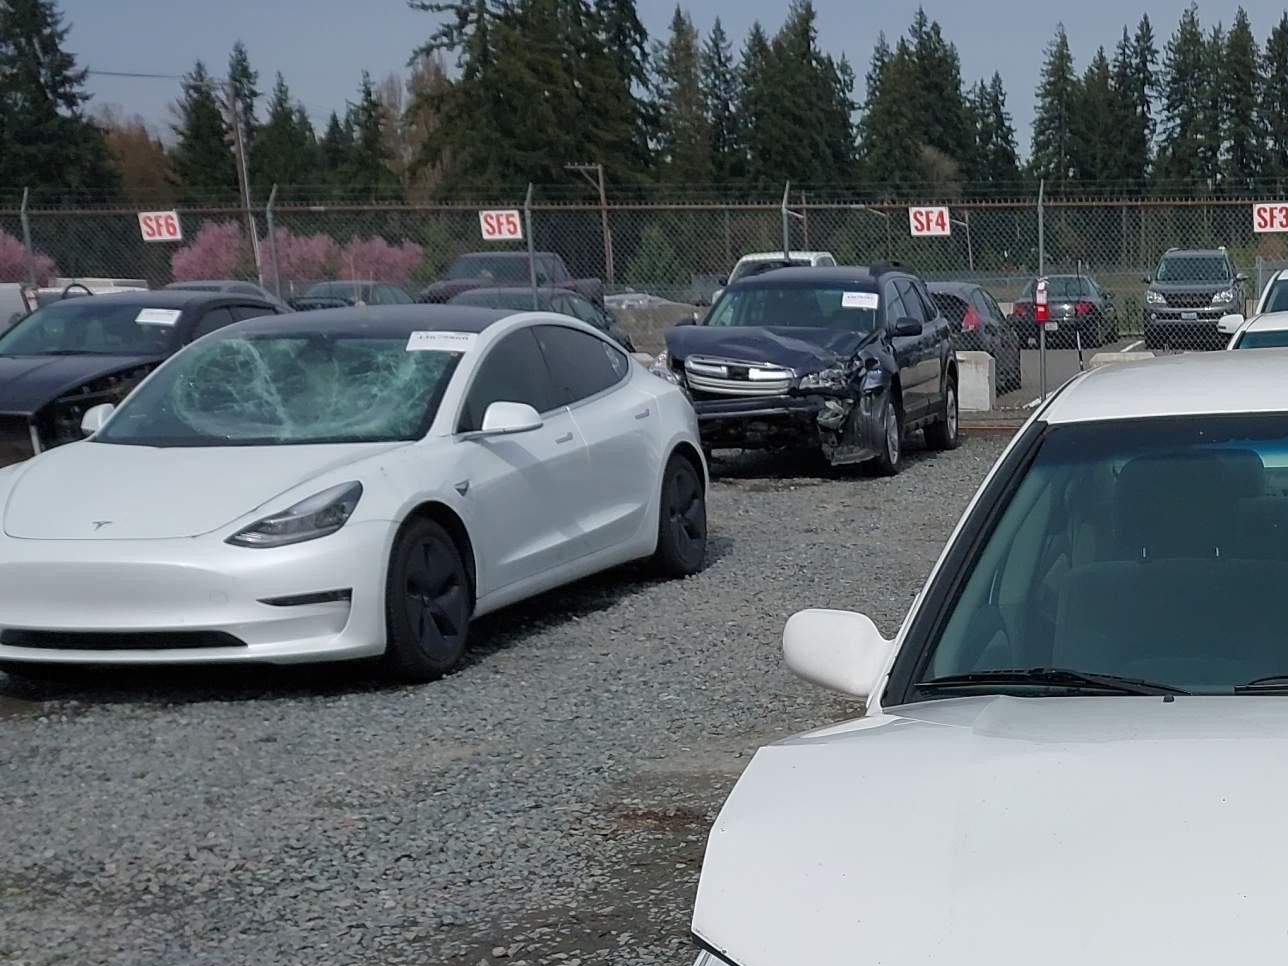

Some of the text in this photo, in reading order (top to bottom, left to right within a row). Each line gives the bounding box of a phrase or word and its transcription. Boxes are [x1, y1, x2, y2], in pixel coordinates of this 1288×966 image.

[143, 215, 178, 238] SF6
[484, 212, 519, 235] SF5
[912, 209, 946, 232] SF4
